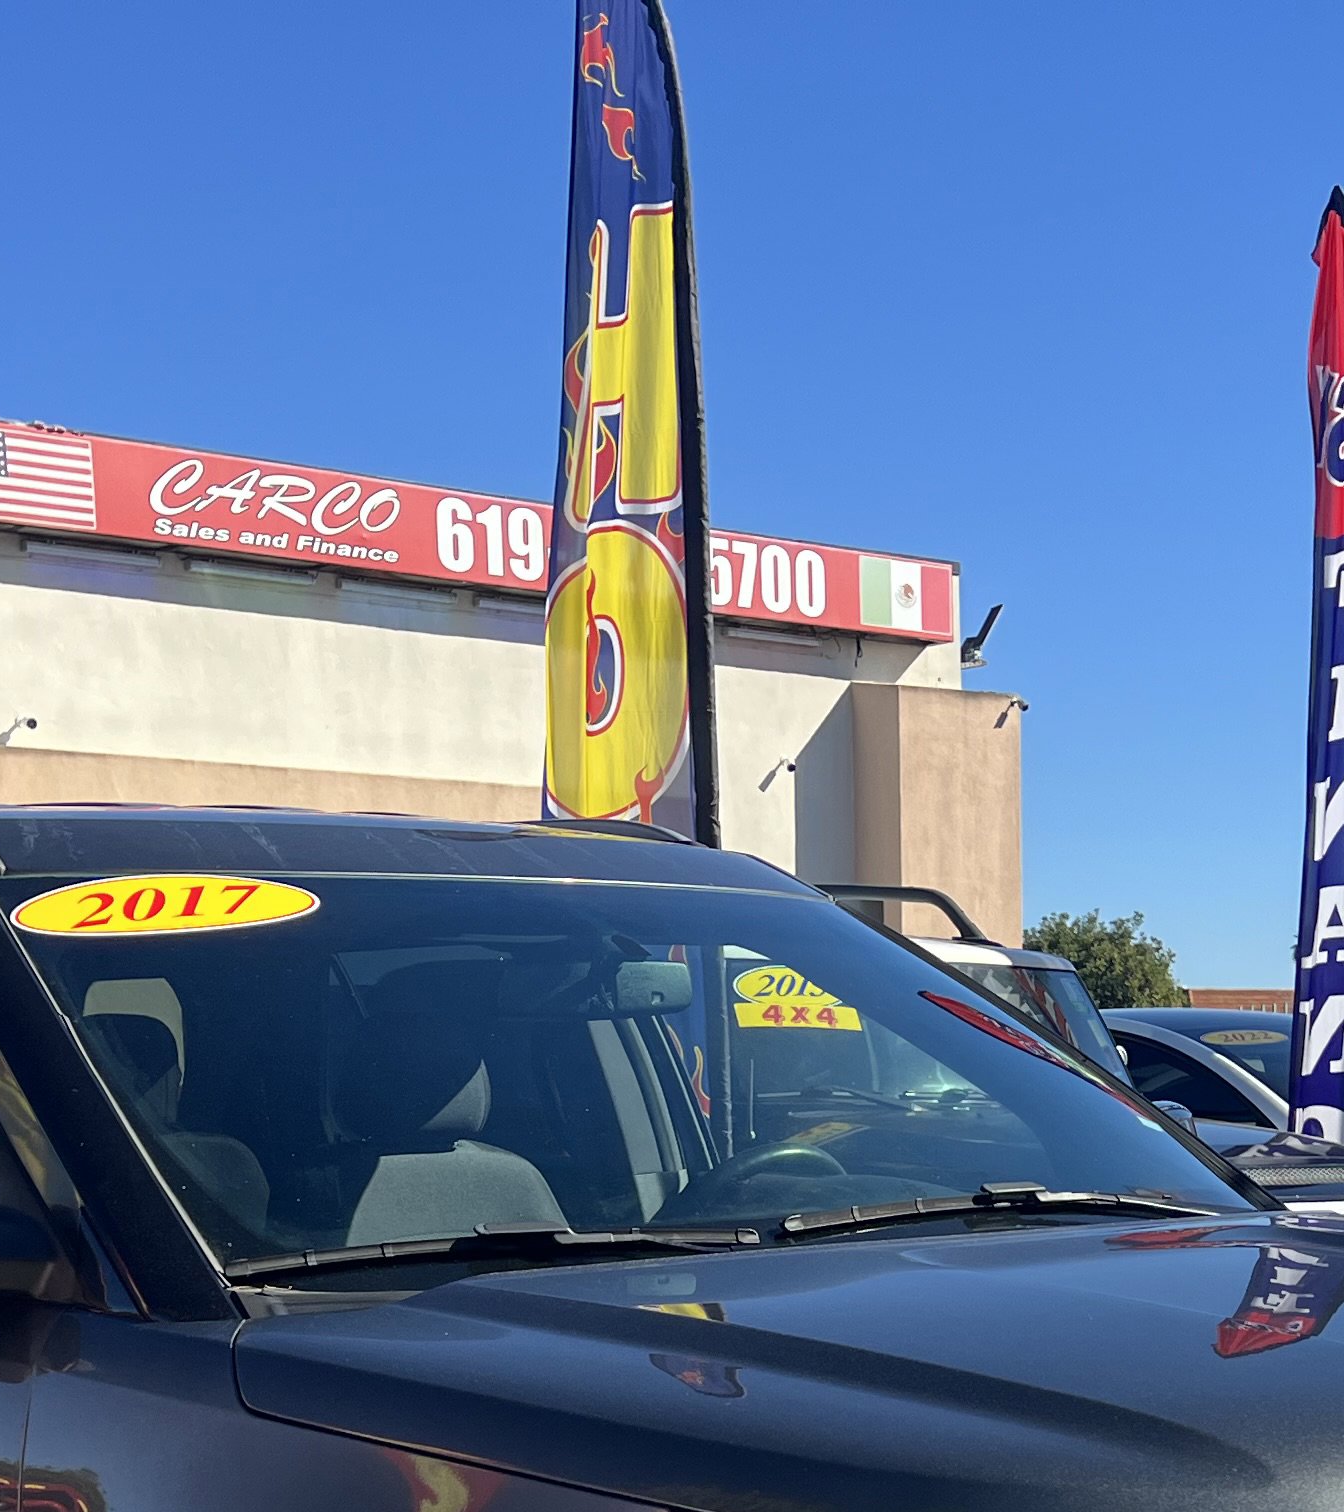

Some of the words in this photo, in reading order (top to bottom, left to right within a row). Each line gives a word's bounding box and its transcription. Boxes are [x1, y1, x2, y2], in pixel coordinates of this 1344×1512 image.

[149, 459, 401, 535] CARCO
[153, 518, 230, 542] Sales
[239, 529, 288, 550] and
[297, 537, 400, 564] Finance
[71, 885, 262, 929] 2017
[1218, 1032, 1273, 1043] 2022
